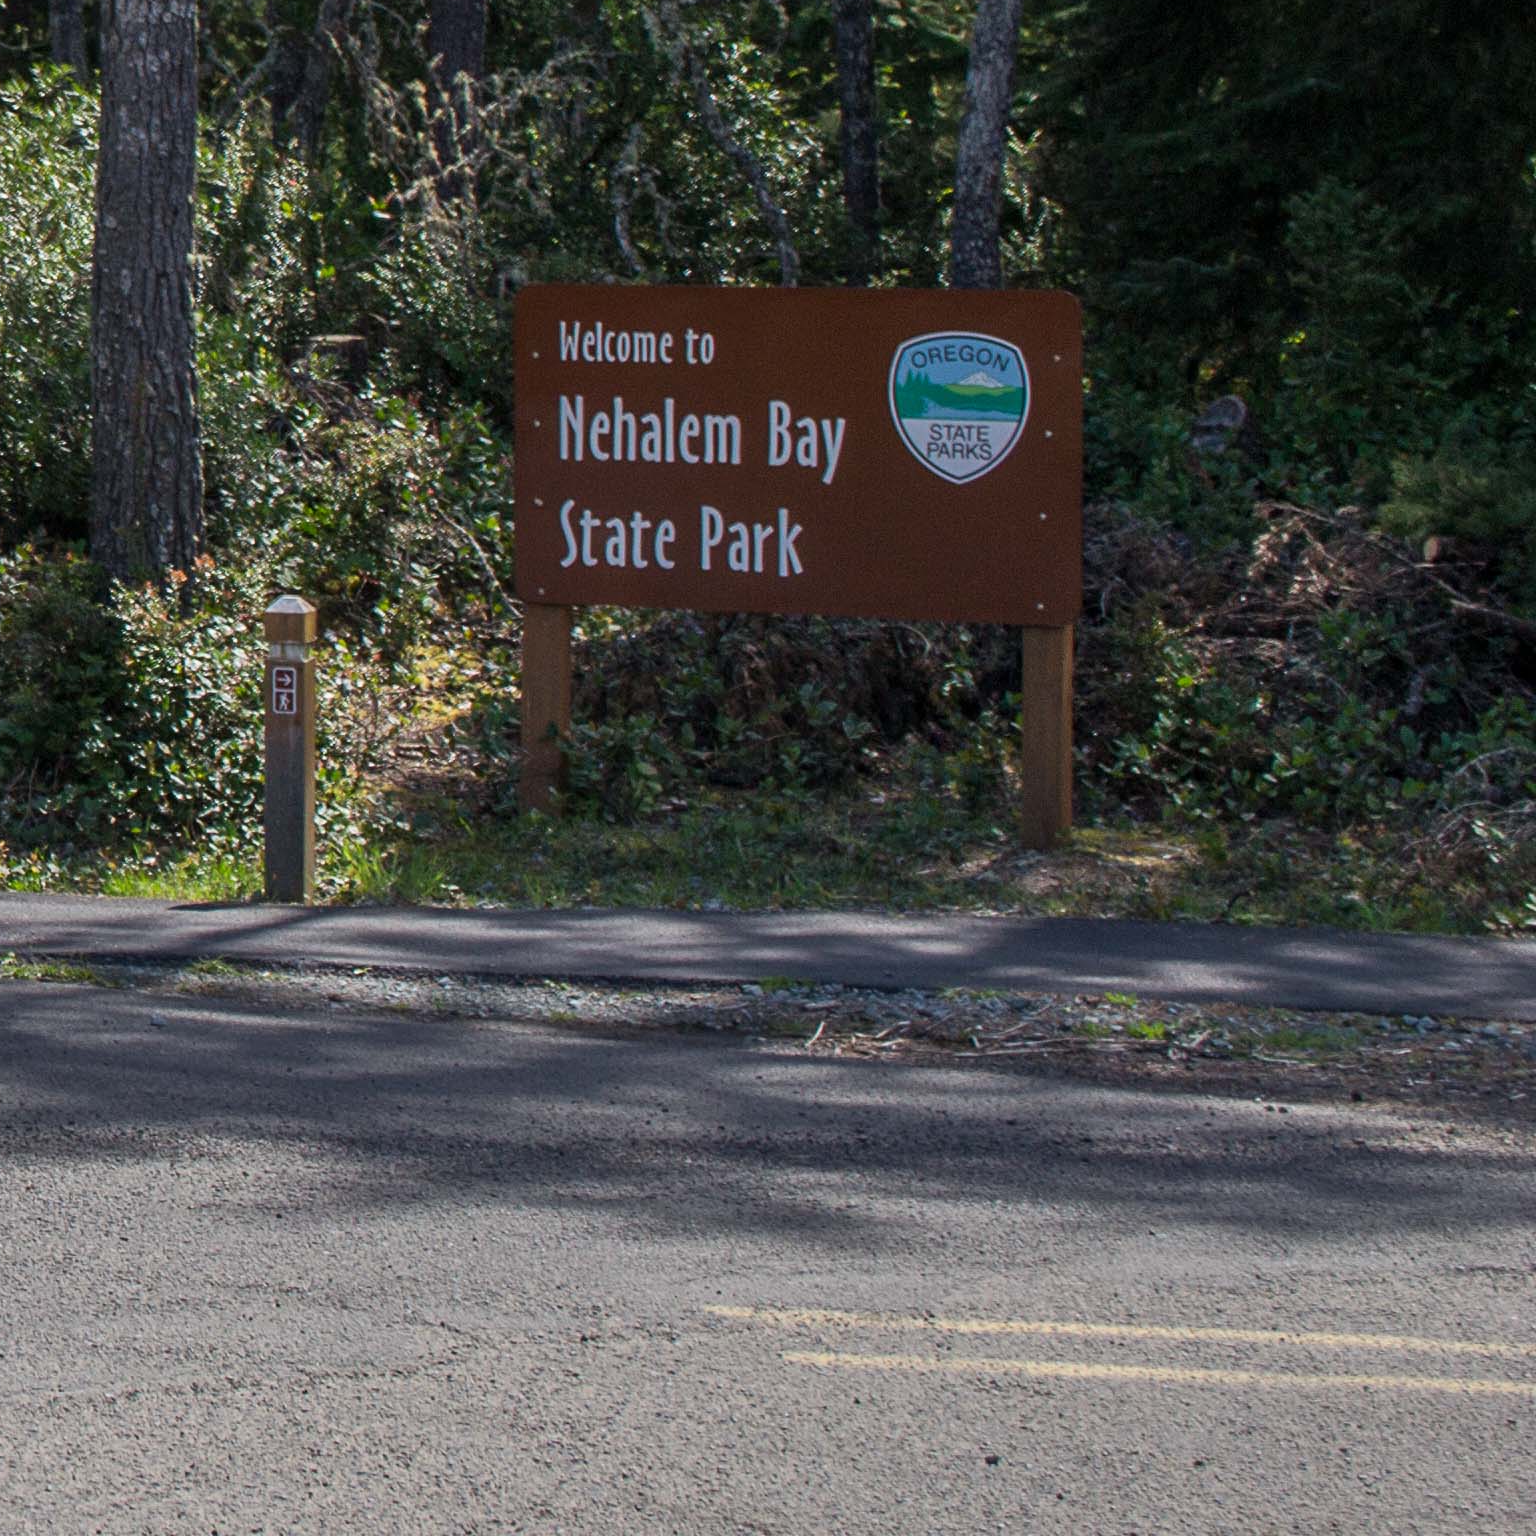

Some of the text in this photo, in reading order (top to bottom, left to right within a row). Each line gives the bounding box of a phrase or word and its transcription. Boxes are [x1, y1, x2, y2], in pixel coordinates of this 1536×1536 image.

[559, 321, 715, 365] Welcome to
[911, 344, 1010, 372] OREGON
[559, 395, 846, 485] Nehalem Bay
[929, 423, 990, 443] STATE
[928, 442, 992, 461] PARKS
[560, 499, 804, 578] State Park
